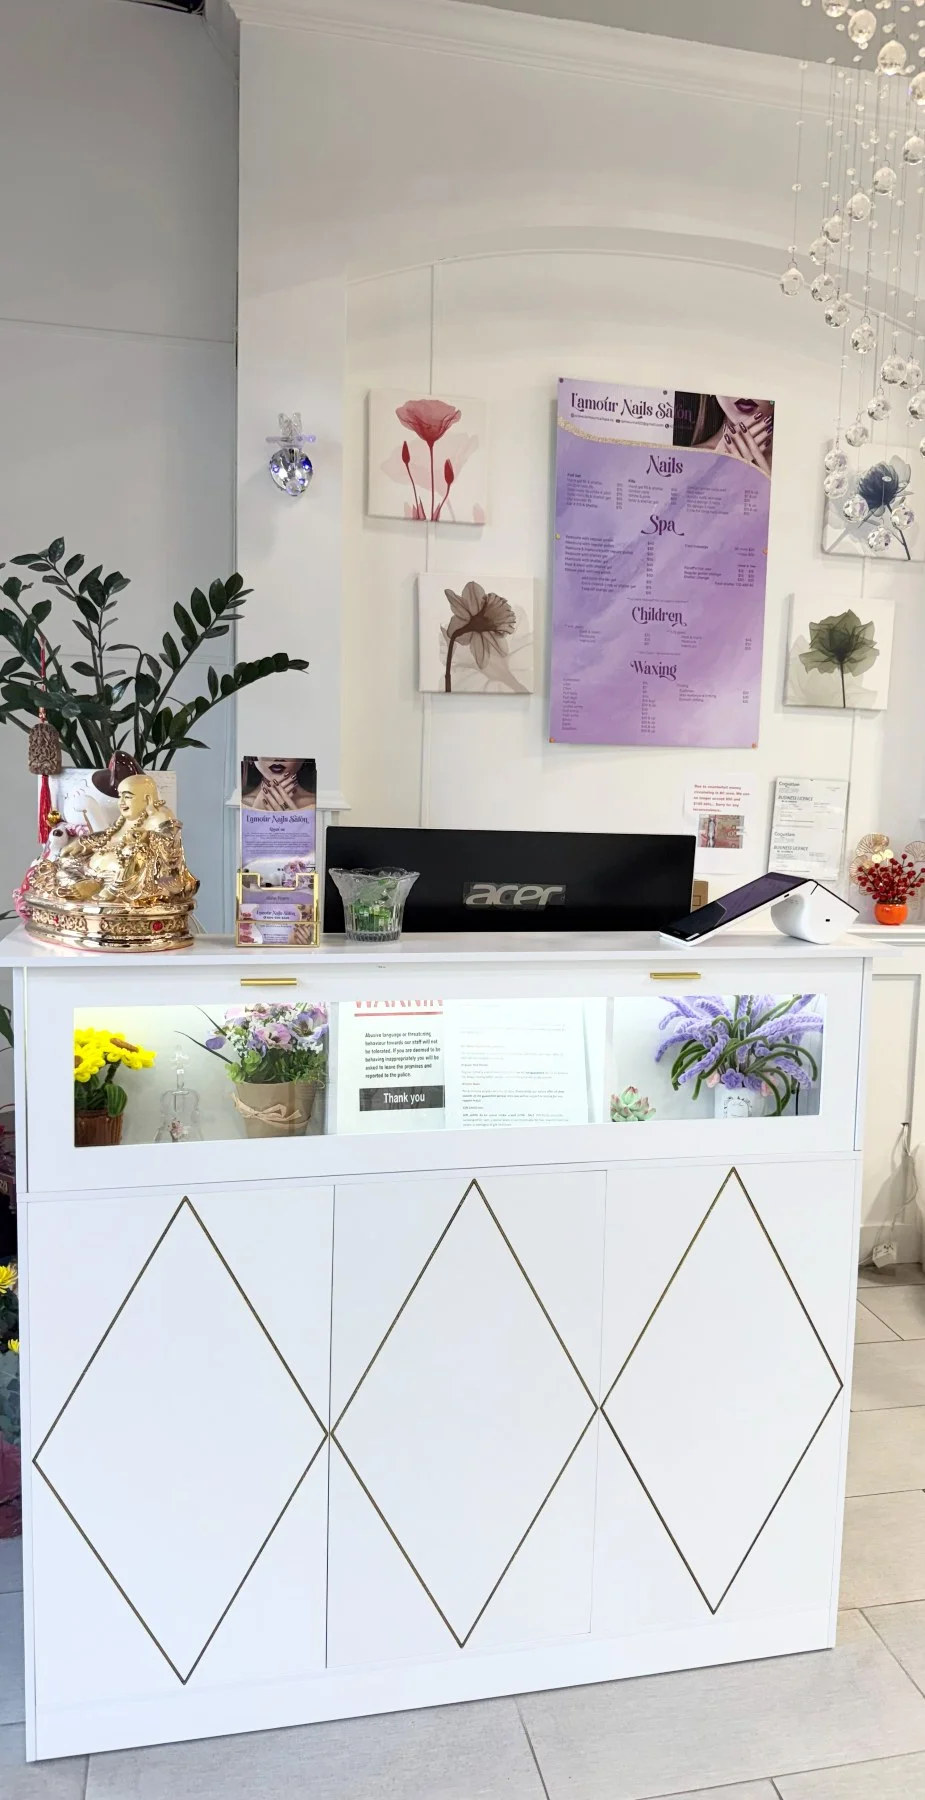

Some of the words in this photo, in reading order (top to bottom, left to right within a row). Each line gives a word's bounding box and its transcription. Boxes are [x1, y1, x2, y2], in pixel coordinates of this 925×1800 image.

[620, 398, 653, 419] Nails
[646, 455, 684, 478] Nails
[640, 514, 684, 536] Spa
[631, 606, 687, 627] Children
[629, 660, 677, 680] Waxing
[466, 884, 563, 905] acer
[383, 1092, 409, 1104] Thank
[410, 1092, 426, 1105] you
